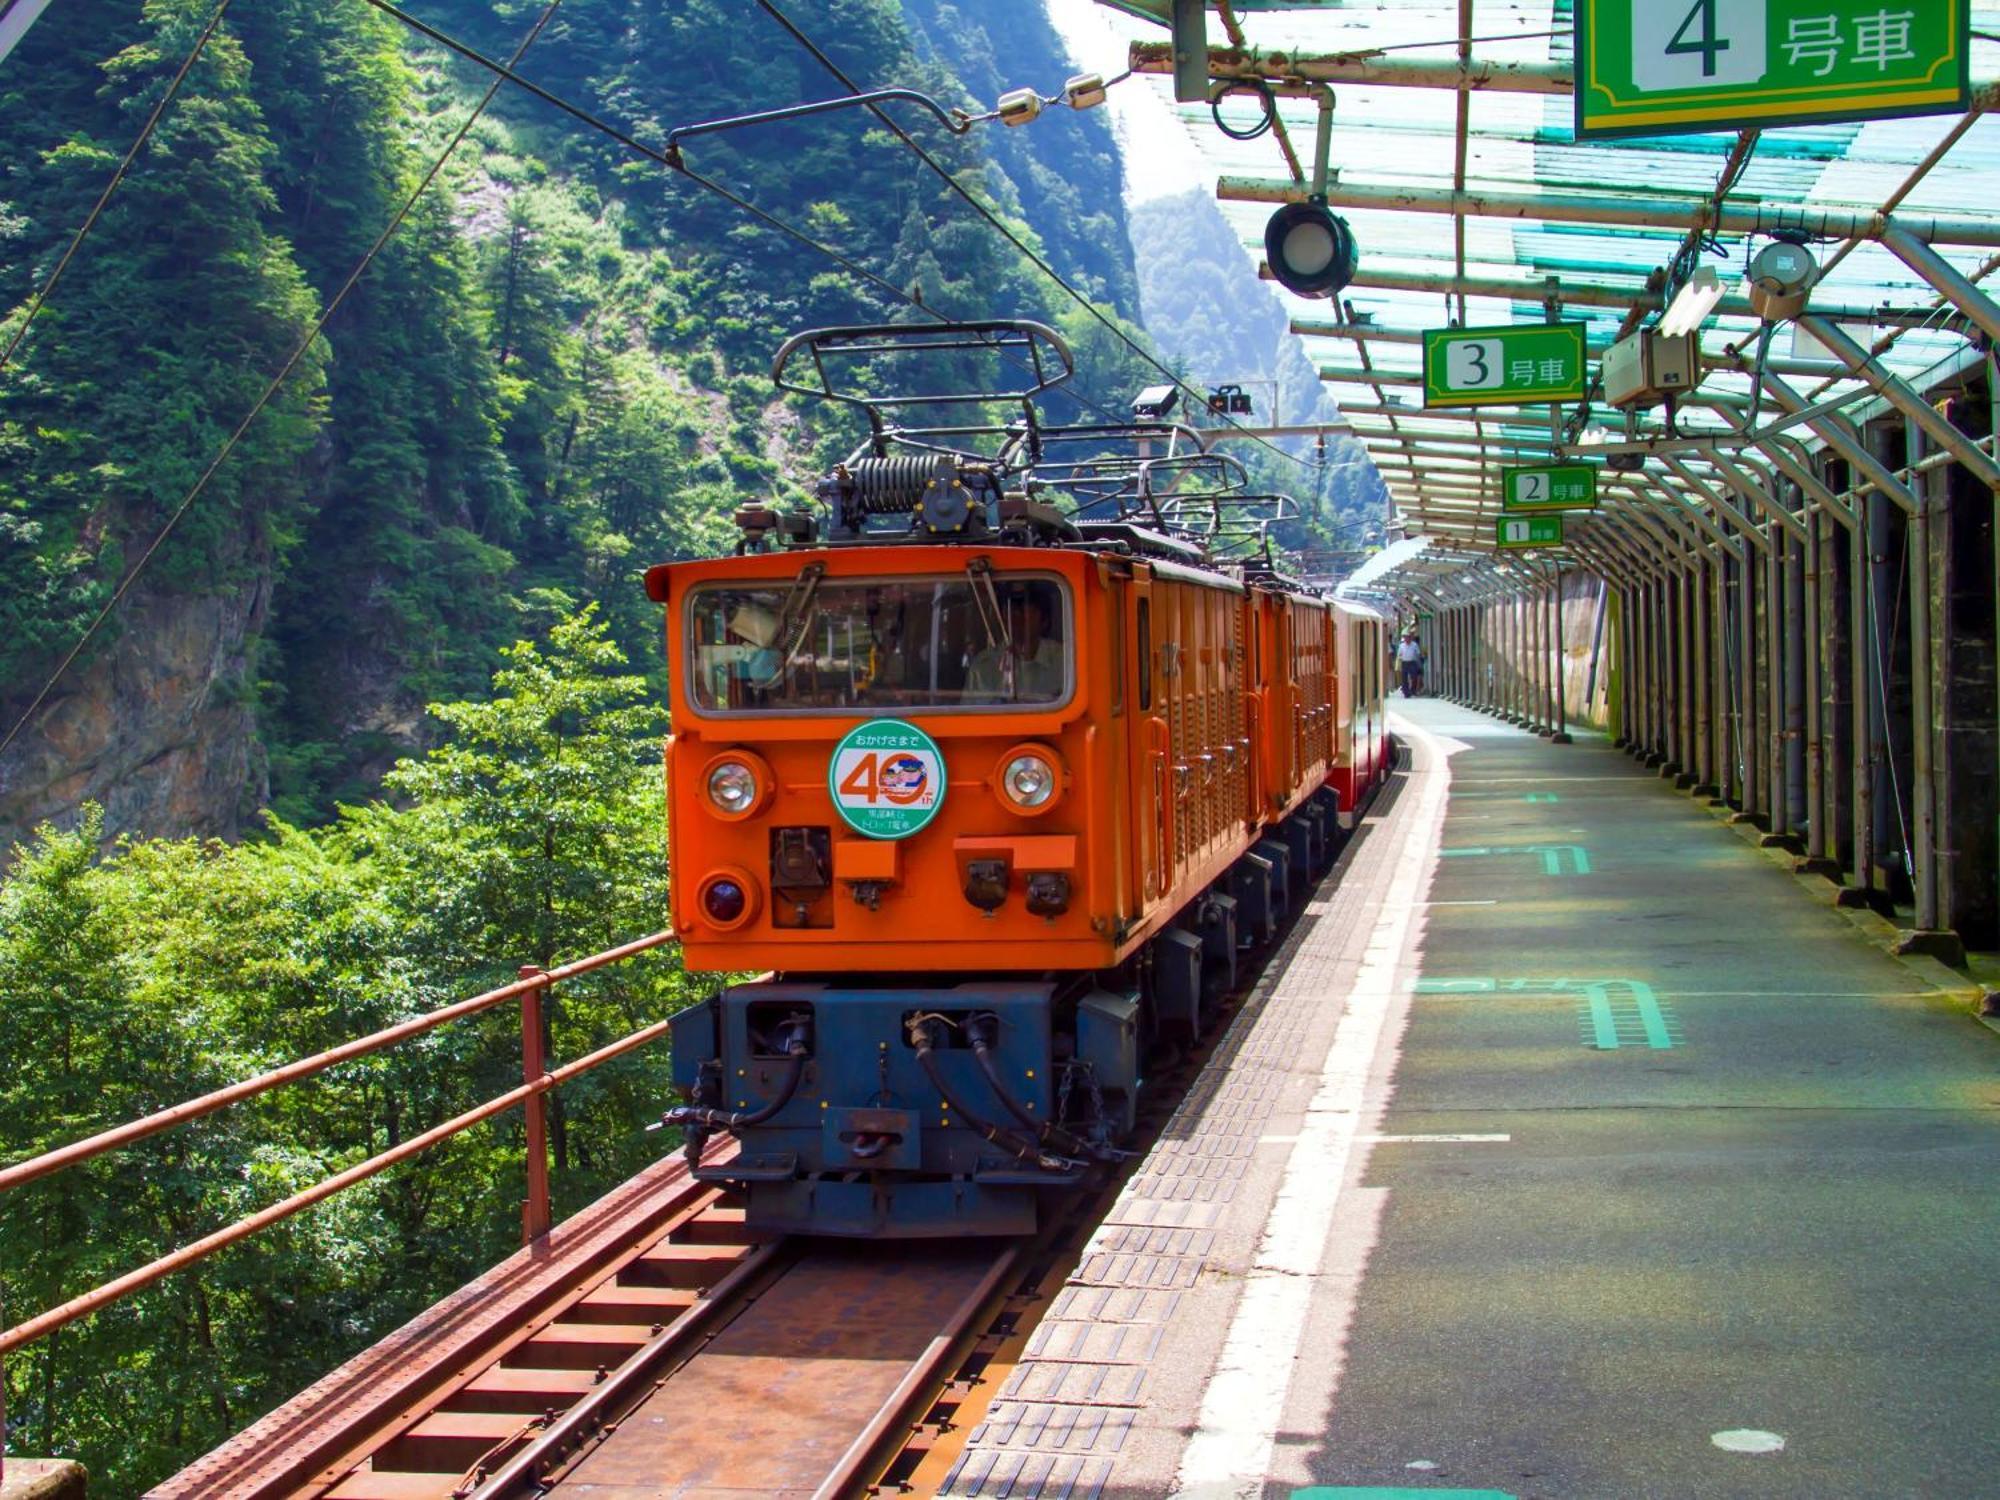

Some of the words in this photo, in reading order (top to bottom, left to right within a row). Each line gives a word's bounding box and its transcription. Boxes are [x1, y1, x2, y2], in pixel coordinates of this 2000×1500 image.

[855, 735, 920, 746] おかげさまで
